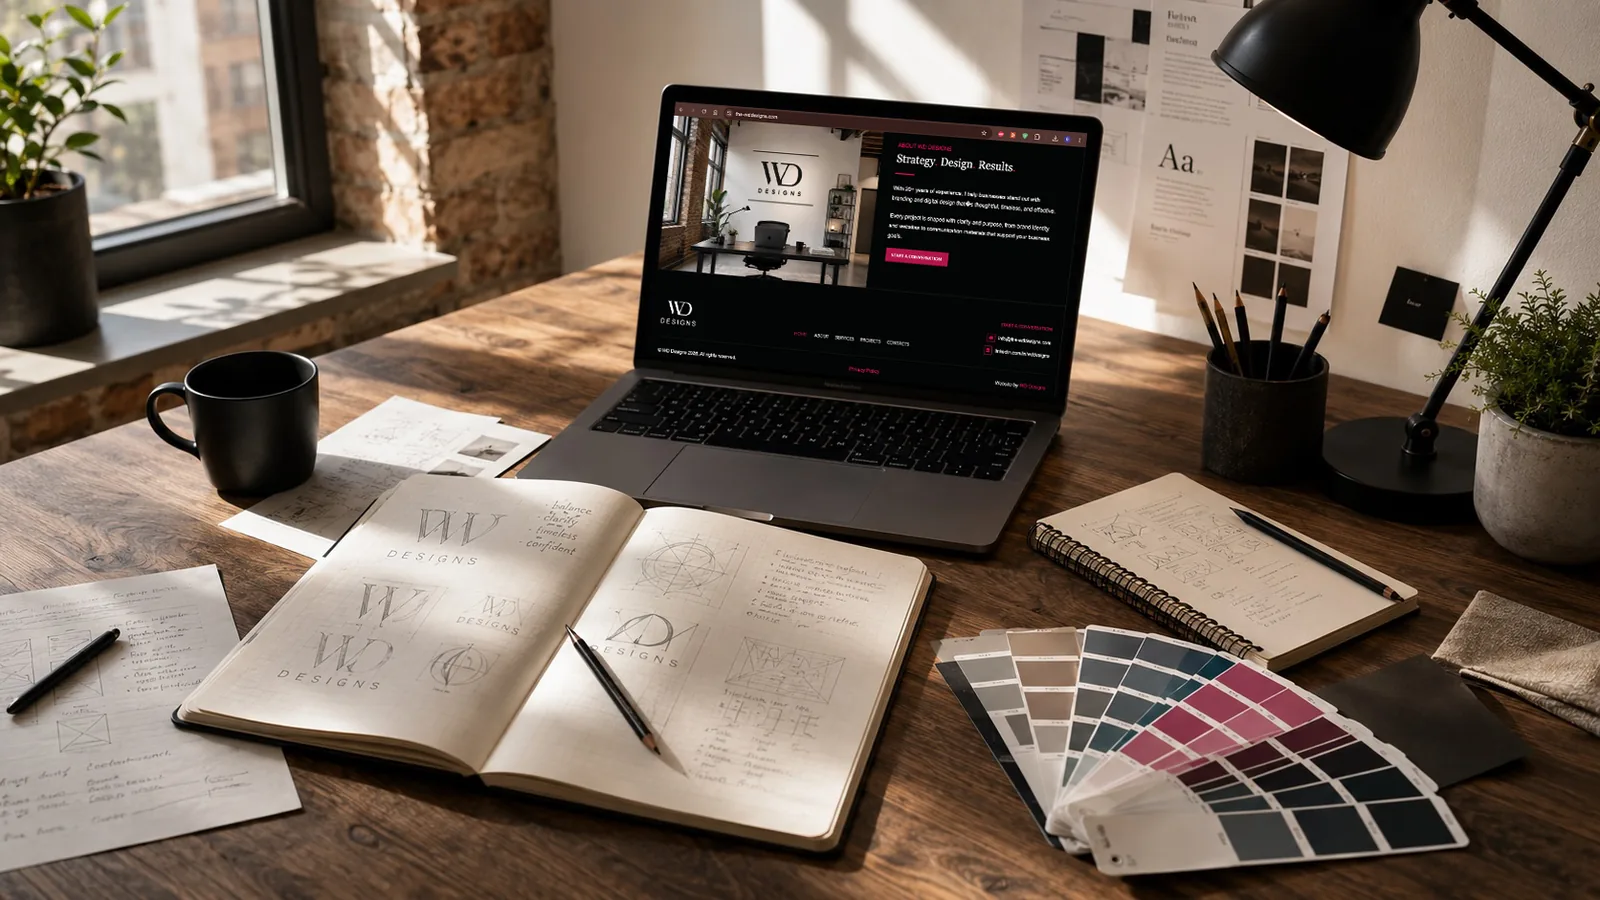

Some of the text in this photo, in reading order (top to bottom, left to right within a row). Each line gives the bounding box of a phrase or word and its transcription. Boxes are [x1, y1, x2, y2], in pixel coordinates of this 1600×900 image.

[896, 153, 1016, 172] Strategy. Design. Results.
[1158, 143, 1194, 174] Aa
[760, 160, 803, 187] WD
[757, 187, 802, 197] DESIGNS
[892, 195, 913, 203] branding
[668, 300, 693, 316] WD
[660, 317, 697, 327] DESIGNS
[552, 500, 592, 515] balance
[543, 512, 579, 528] clarity
[536, 526, 578, 541] timeless
[526, 540, 576, 556] confident
[386, 550, 478, 566] DESIGNS
[456, 616, 521, 636] DESIGNS
[277, 669, 381, 691] DESIGNS
